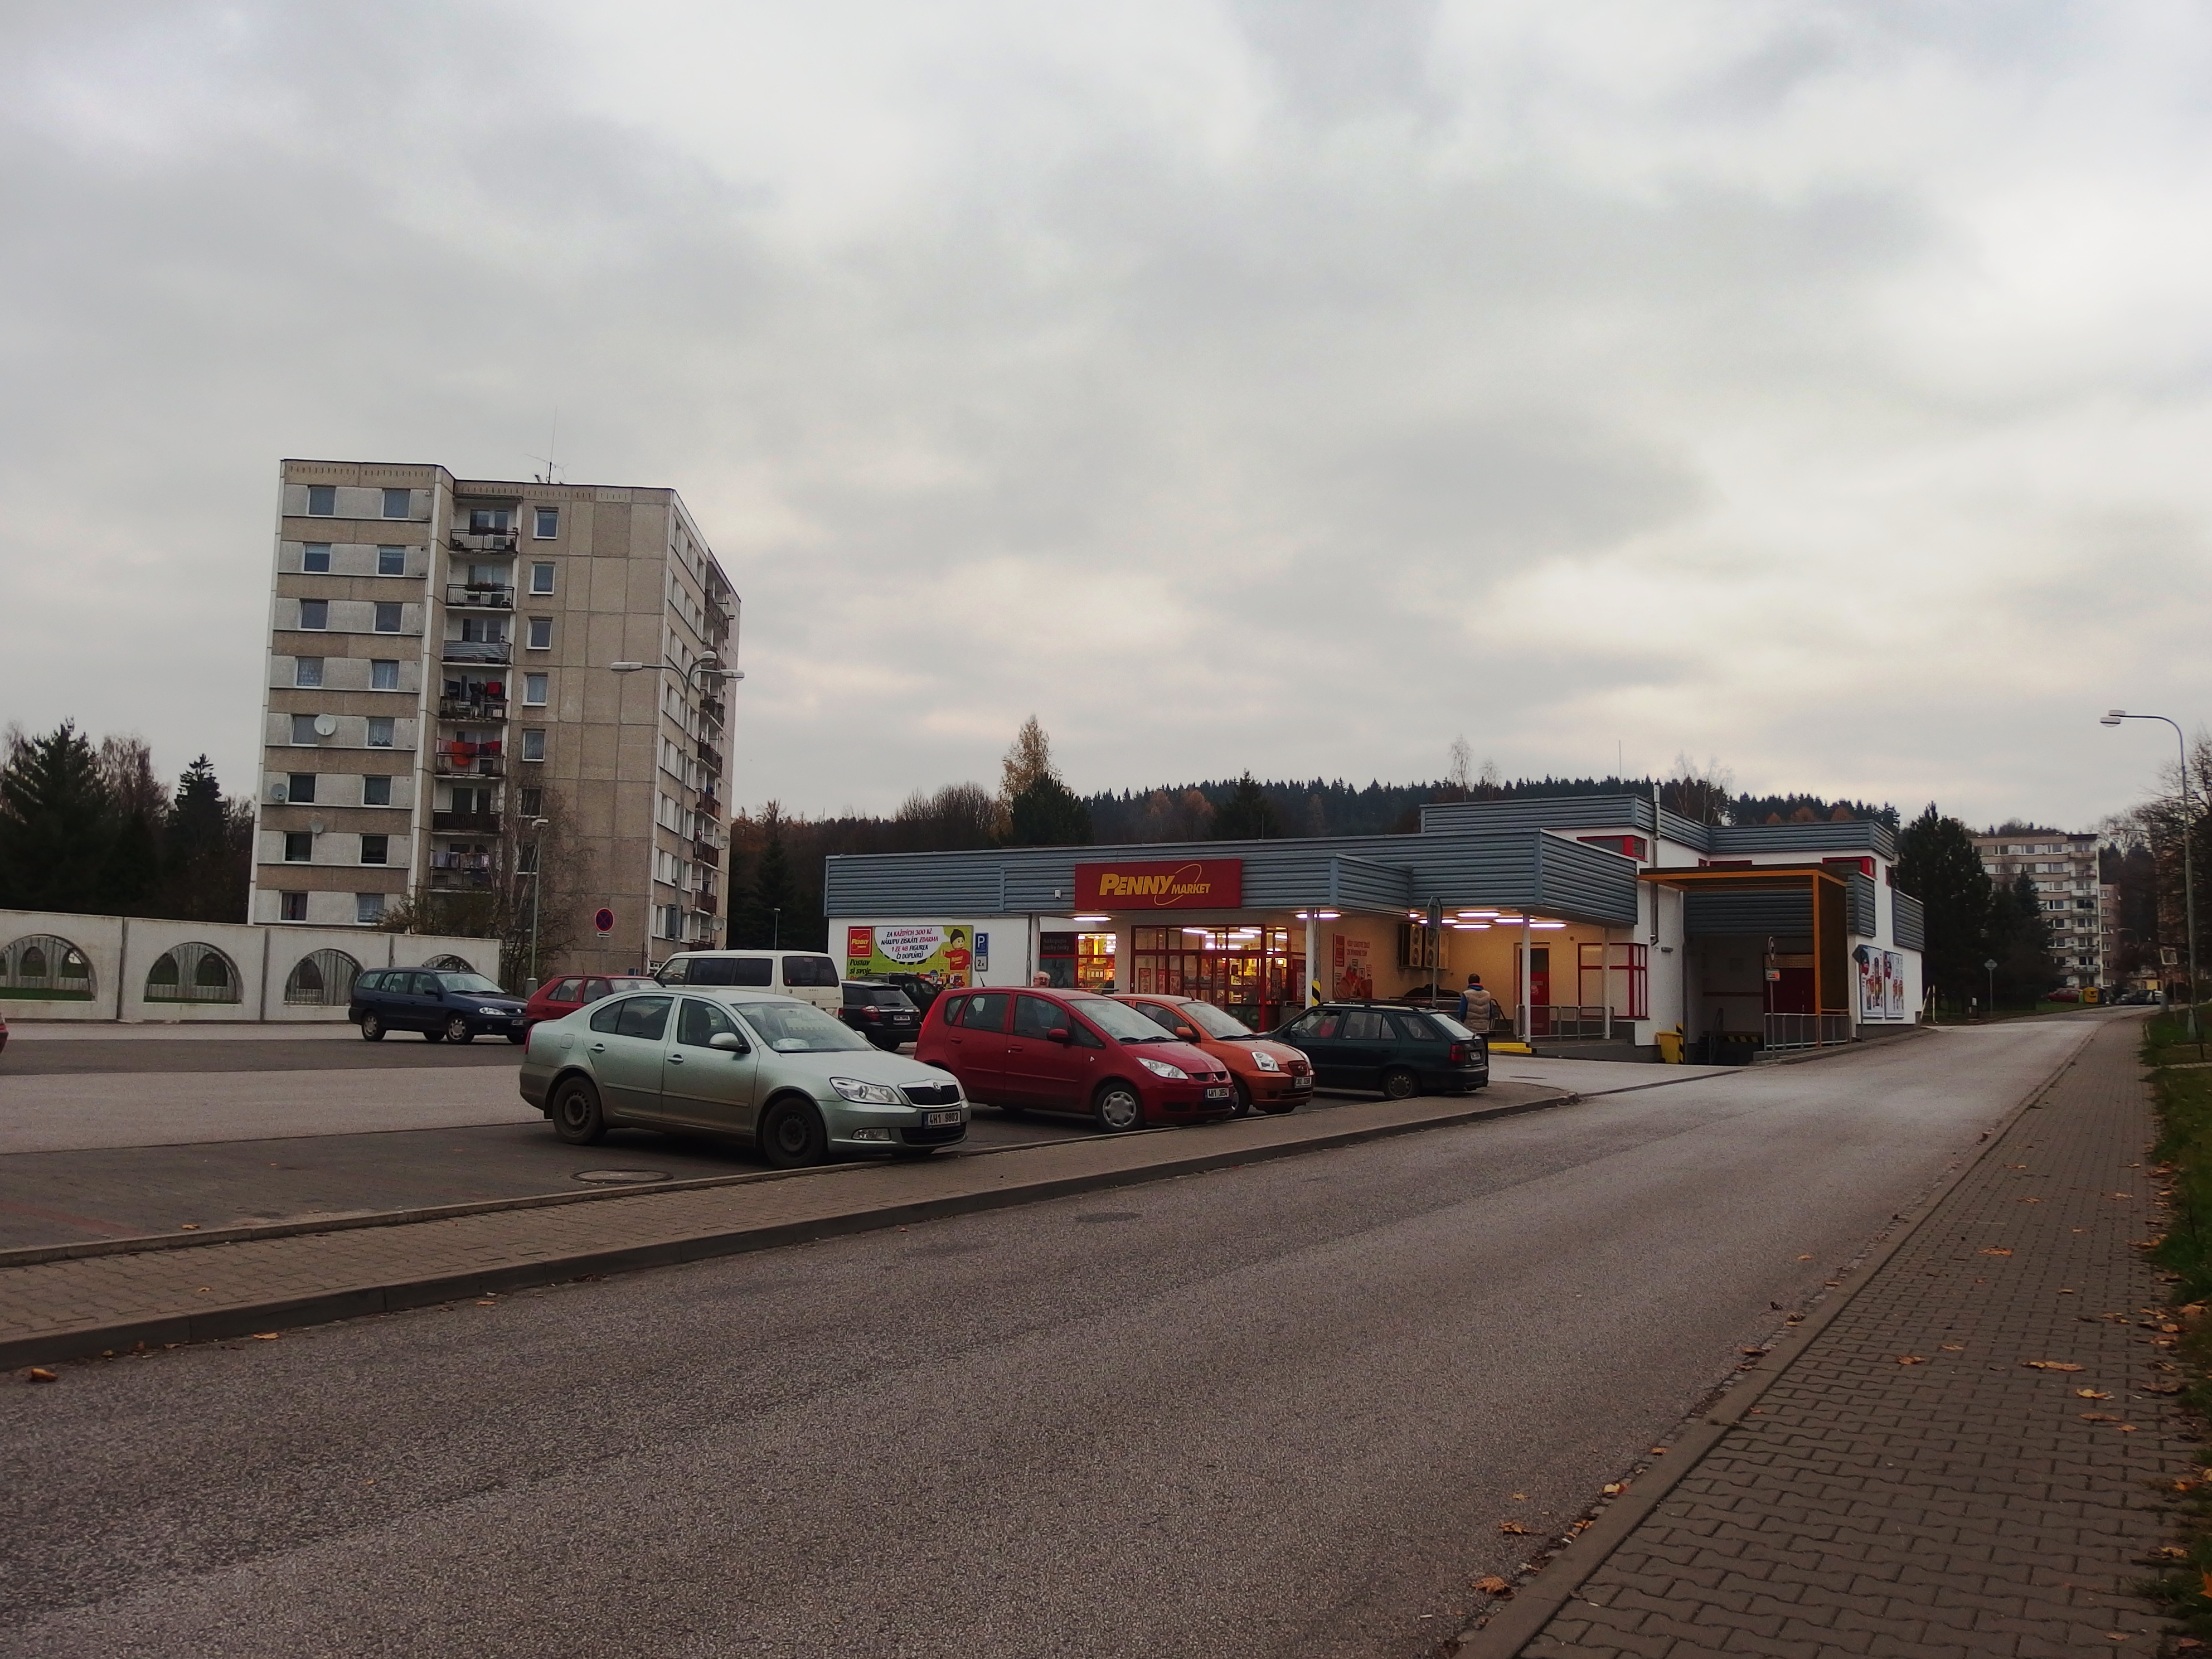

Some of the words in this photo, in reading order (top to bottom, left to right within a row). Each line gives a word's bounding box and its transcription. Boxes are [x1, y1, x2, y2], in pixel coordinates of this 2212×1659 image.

[1099, 873, 1175, 896] PENNY
[1171, 883, 1211, 895] MARKET
[978, 935, 985, 948] P
[856, 967, 872, 976] svoje
[929, 1114, 941, 1124] 4H1
[945, 1112, 958, 1123] 9803
